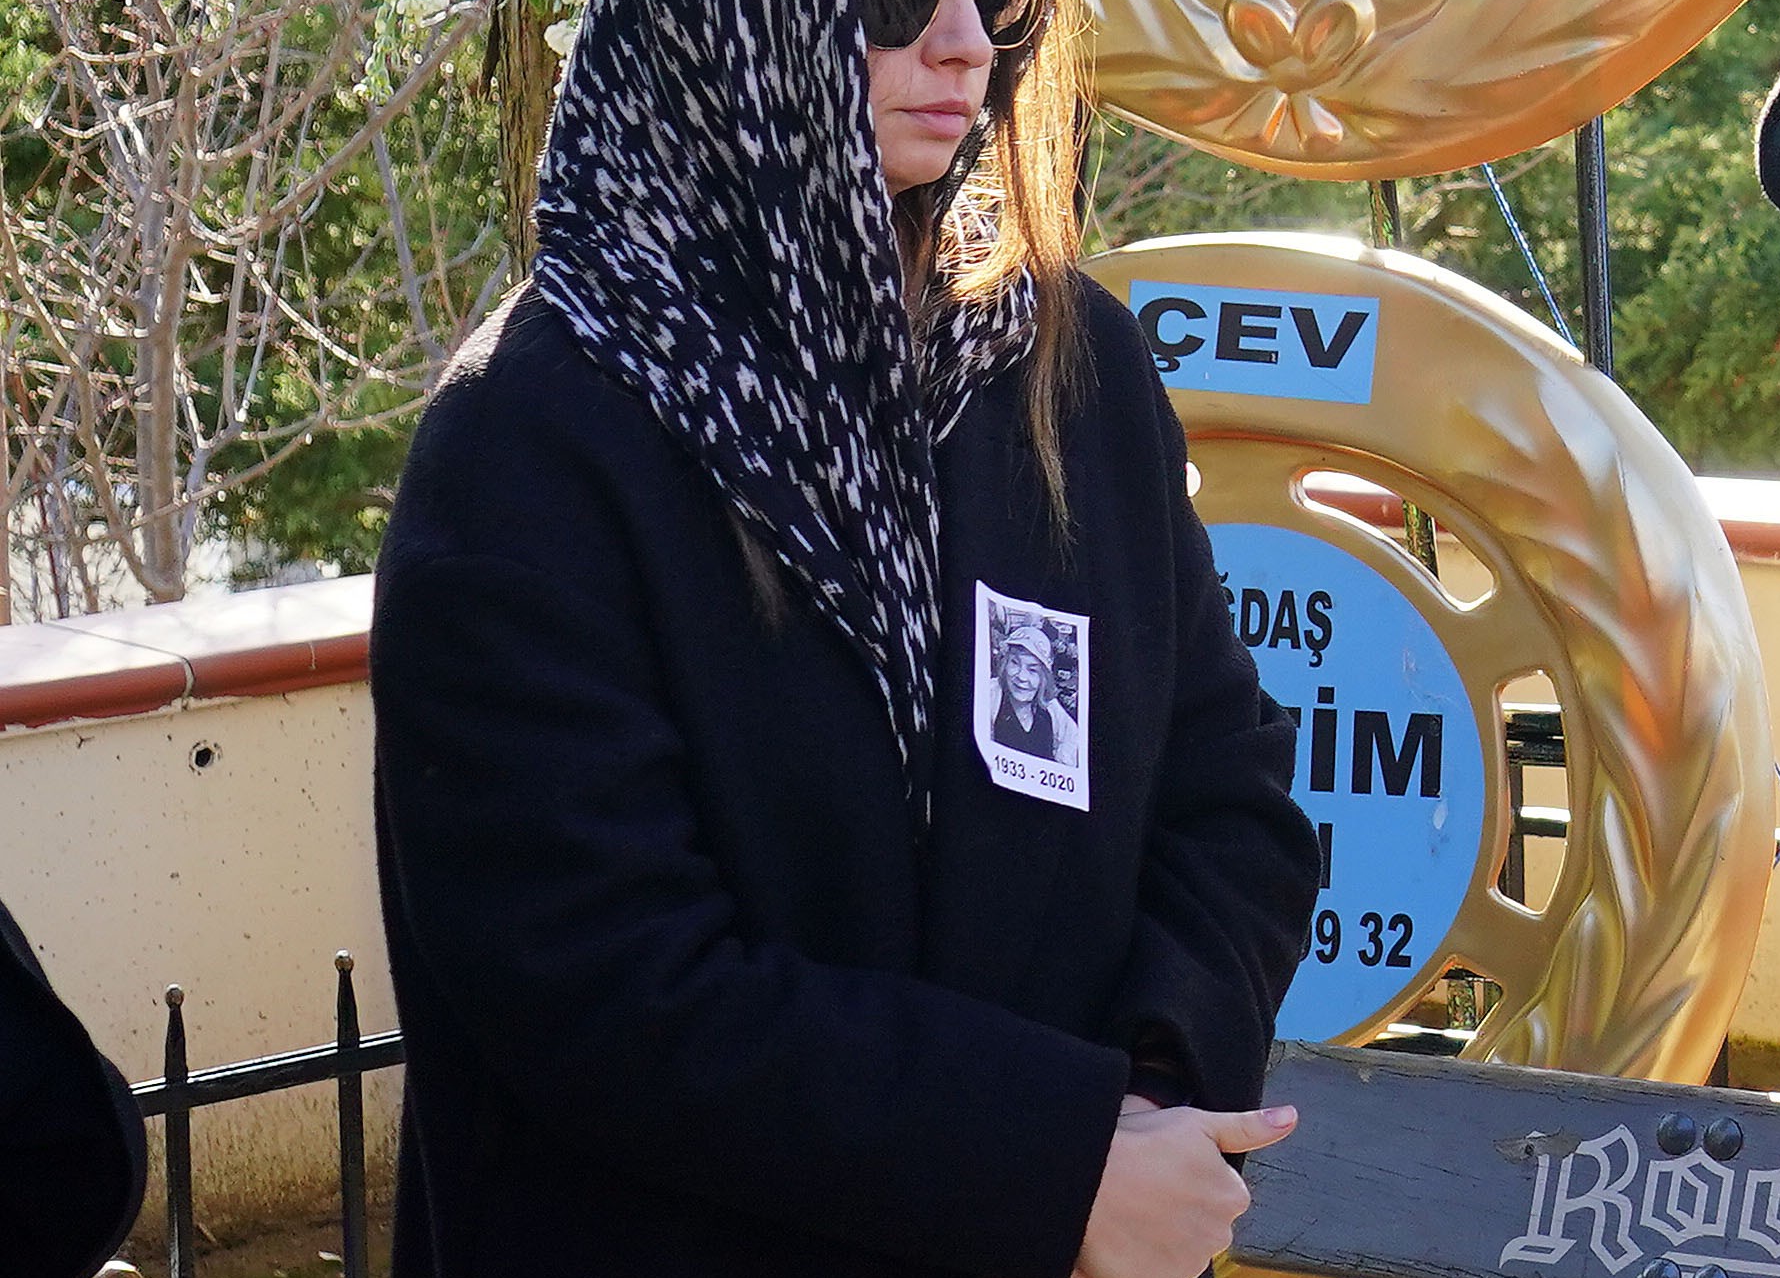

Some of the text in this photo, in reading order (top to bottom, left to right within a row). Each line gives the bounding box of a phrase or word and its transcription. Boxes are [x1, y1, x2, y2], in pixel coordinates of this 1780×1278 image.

[1136, 296, 1370, 373] ÇEV
[994, 754, 1026, 780] 1933
[1039, 769, 1075, 793] 2020
[1356, 911, 1414, 969] 32
